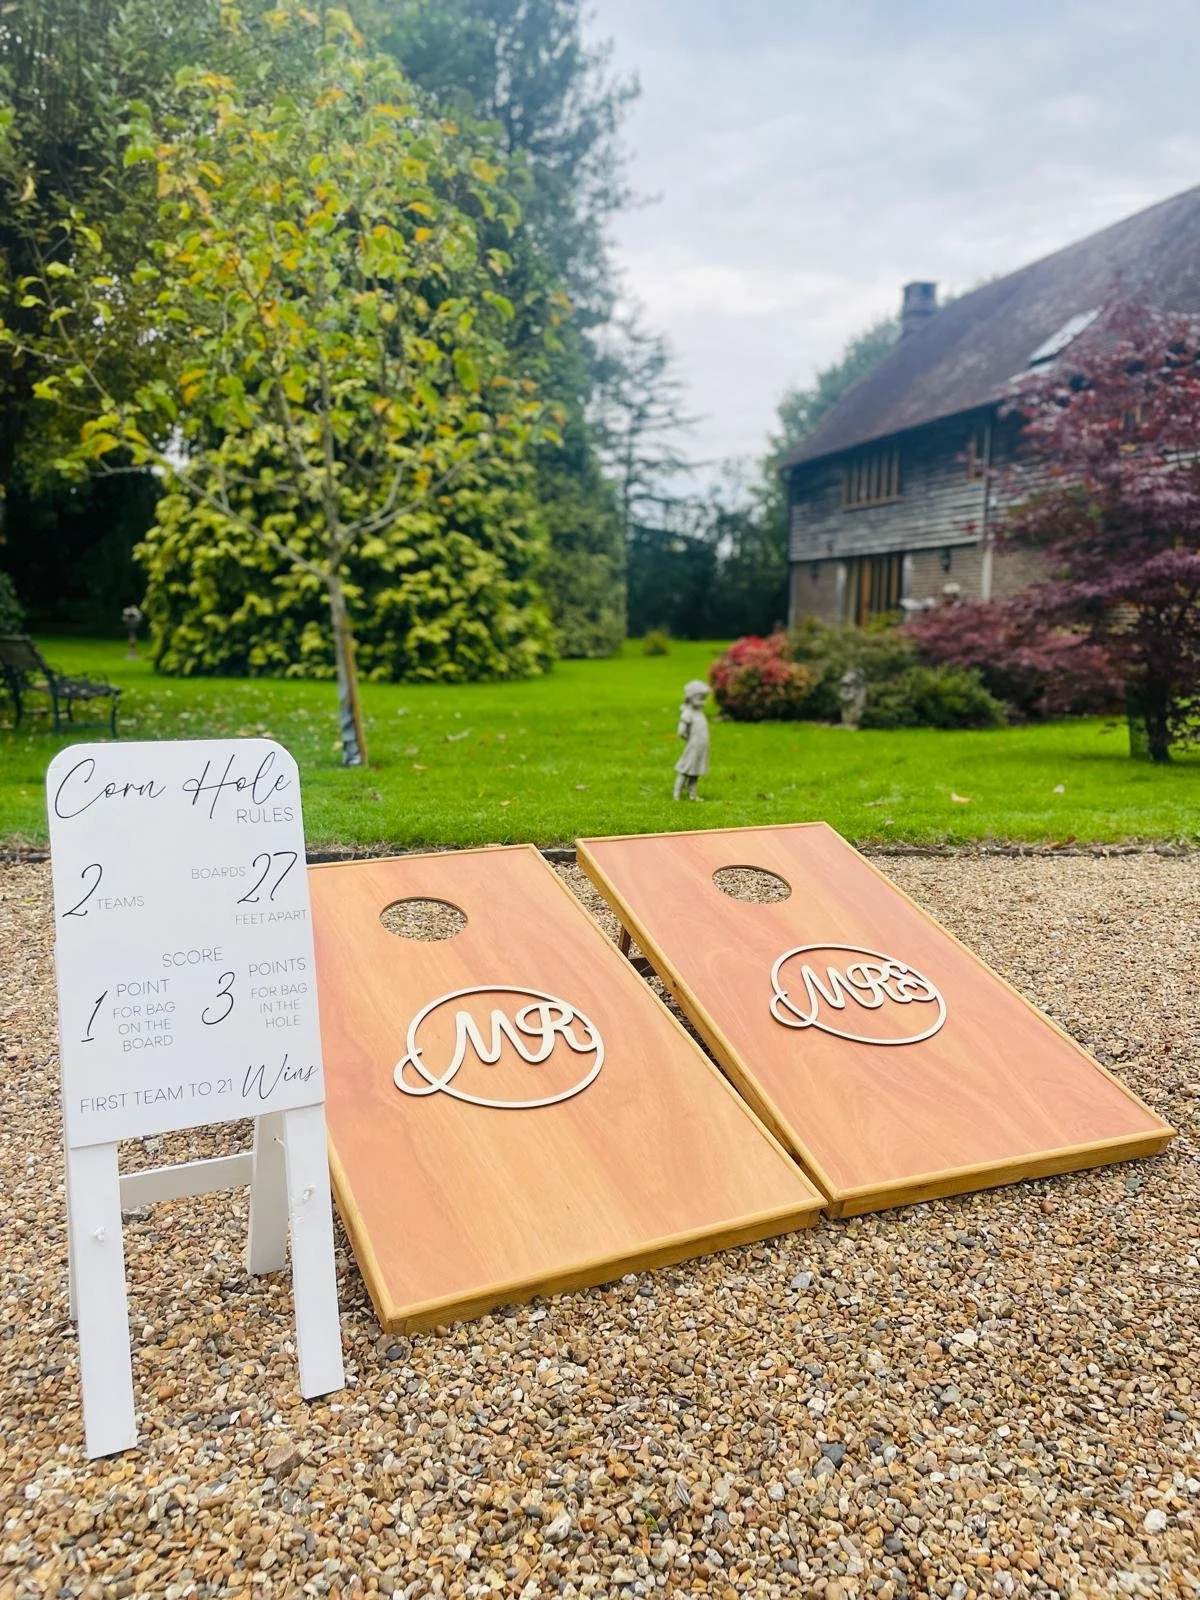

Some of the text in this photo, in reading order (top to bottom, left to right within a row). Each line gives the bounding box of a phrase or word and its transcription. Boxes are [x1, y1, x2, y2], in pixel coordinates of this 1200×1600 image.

[55, 751, 292, 819] Corn Hole
[237, 807, 294, 824] RULES
[191, 851, 298, 904] BOARDS 27
[62, 863, 145, 918] 2 TEAMS
[235, 909, 308, 926] FEET APART
[162, 947, 223, 968] SCORE
[201, 957, 307, 1025] 3 POINTS
[251, 982, 308, 1000] FOR BAG
[81, 978, 171, 1043] 1 POINT
[113, 1001, 176, 1020] FOR BAG
[259, 998, 301, 1014] IN THE
[118, 1018, 172, 1035] ON THE
[265, 1016, 301, 1029] HOLE
[123, 1034, 174, 1053] BOARD
[80, 1053, 318, 1114] FIRST TEAM TO 21 Wins
